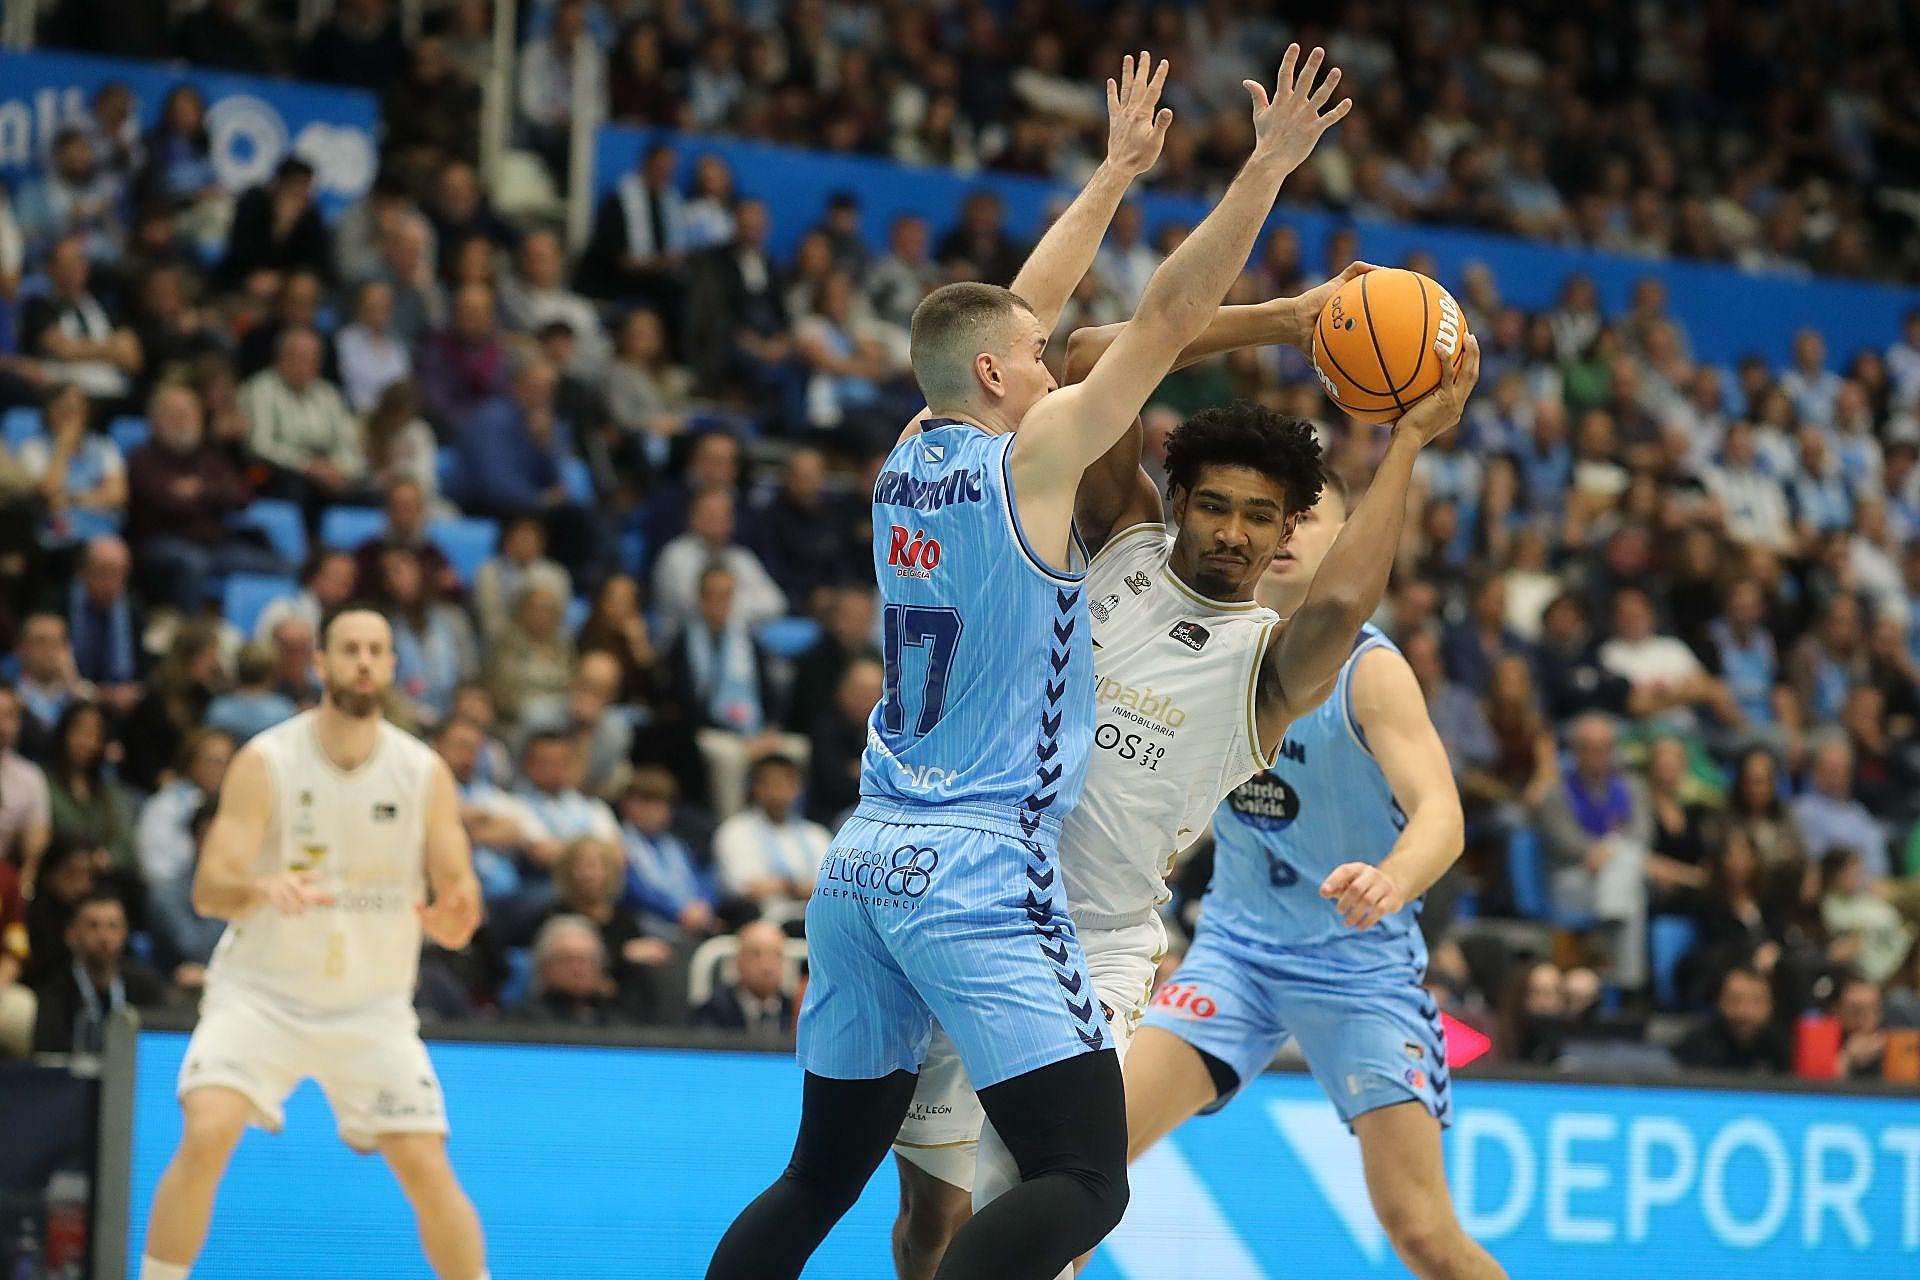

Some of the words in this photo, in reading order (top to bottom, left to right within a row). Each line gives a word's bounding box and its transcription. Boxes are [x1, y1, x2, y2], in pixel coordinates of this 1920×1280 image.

[888, 524, 942, 571] Río
[883, 603, 963, 738] 17
[1111, 705, 1176, 740] INMOBILIARIA
[1139, 754, 1158, 771] 31
[1145, 742, 1165, 758] 20
[925, 1104, 952, 1114] LEÓN
